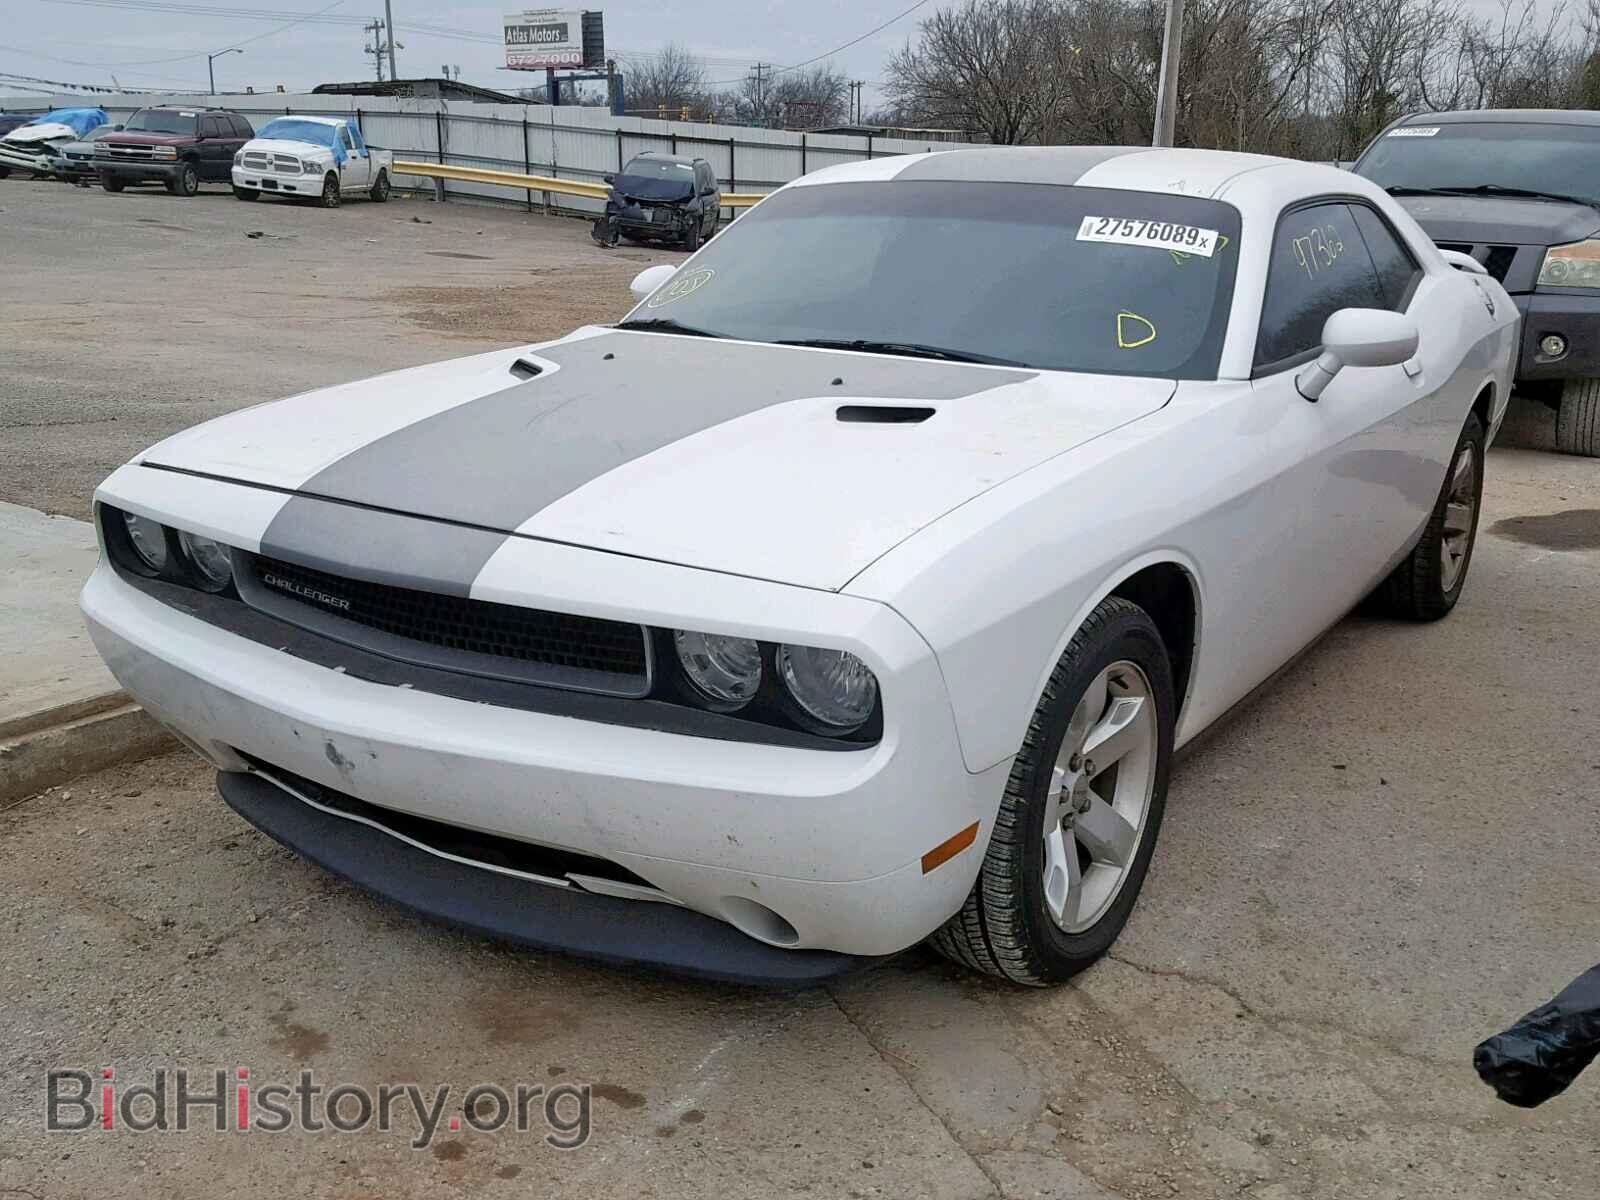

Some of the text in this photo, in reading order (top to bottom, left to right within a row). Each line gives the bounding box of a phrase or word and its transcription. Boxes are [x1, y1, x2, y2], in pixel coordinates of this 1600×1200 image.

[506, 26, 560, 43] Atlas Motors
[264, 574, 350, 610] CHALLENGER
